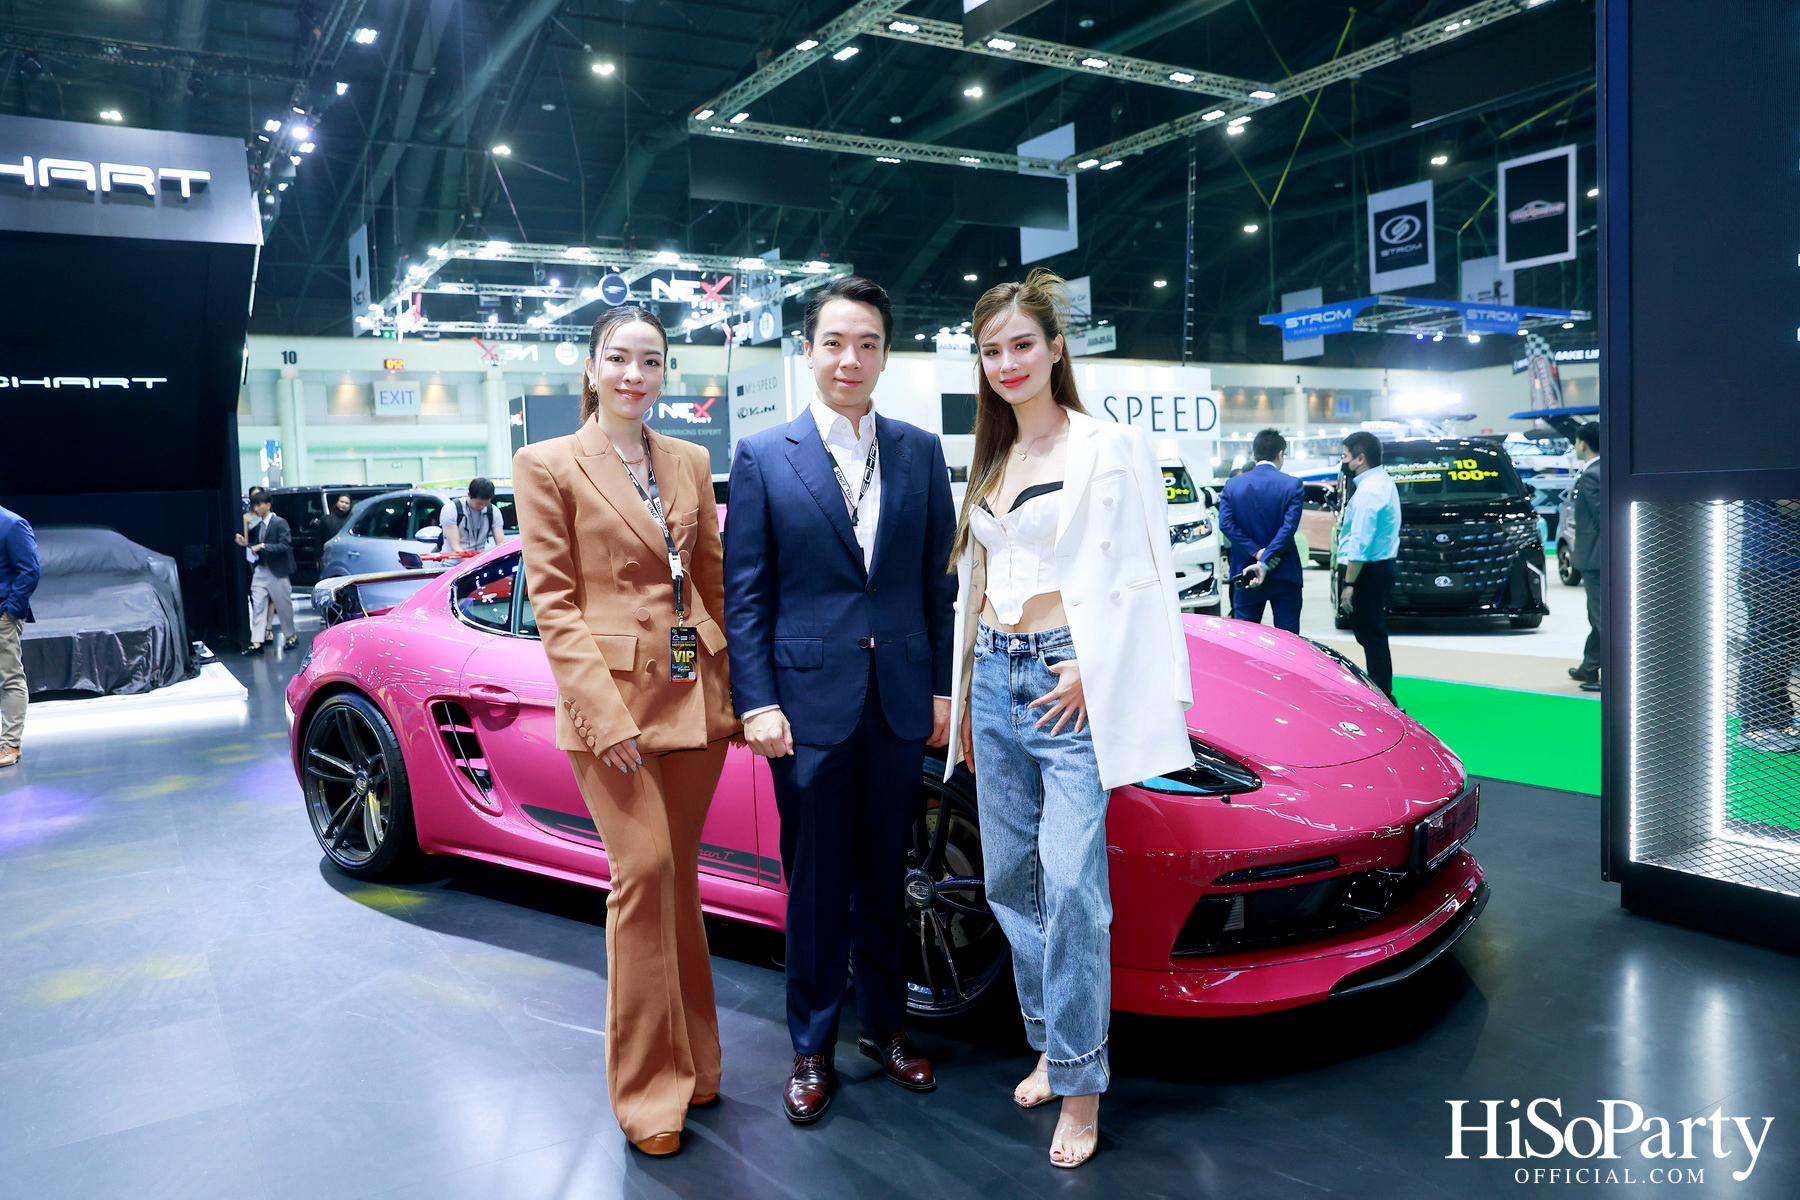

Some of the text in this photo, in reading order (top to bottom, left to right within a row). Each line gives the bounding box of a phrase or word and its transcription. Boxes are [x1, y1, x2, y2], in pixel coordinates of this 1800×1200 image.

[1380, 243, 1422, 257] STROM
[651, 276, 733, 303] NEX
[1285, 307, 1352, 329] STROM
[1466, 308, 1519, 322] STROM
[281, 350, 297, 364] 10
[380, 390, 416, 405] EXIT
[658, 397, 717, 419] NEX
[1104, 395, 1217, 432] SPEED
[673, 650, 695, 663] VIP
[723, 850, 735, 861] T
